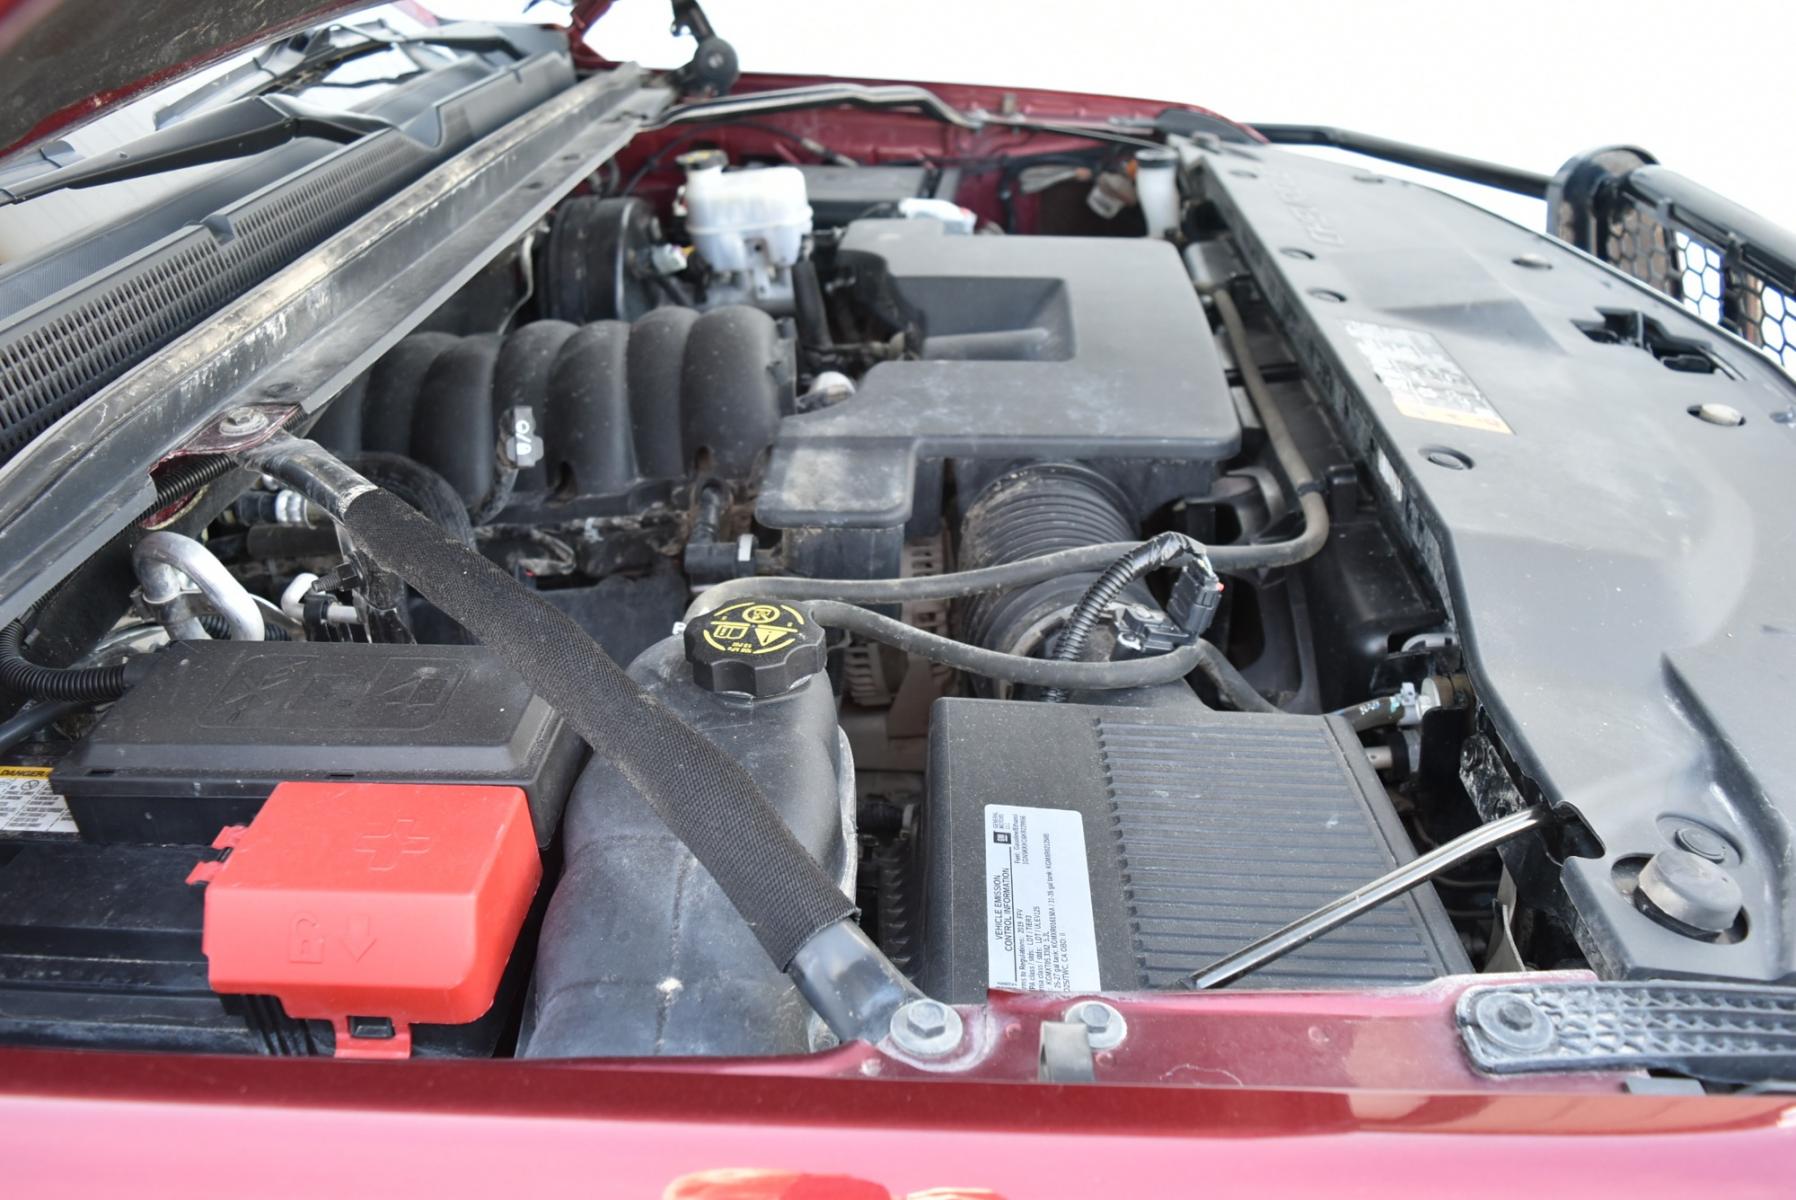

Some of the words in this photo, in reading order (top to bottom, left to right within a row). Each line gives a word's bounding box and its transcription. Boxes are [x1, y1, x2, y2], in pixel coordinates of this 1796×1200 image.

[994, 875, 1003, 908] EMISSION
[1002, 867, 1012, 914] INFORMATION
[995, 909, 1004, 940] VEHICLE
[1004, 916, 1013, 952] CONTROL
[1035, 932, 1043, 944] LDT
